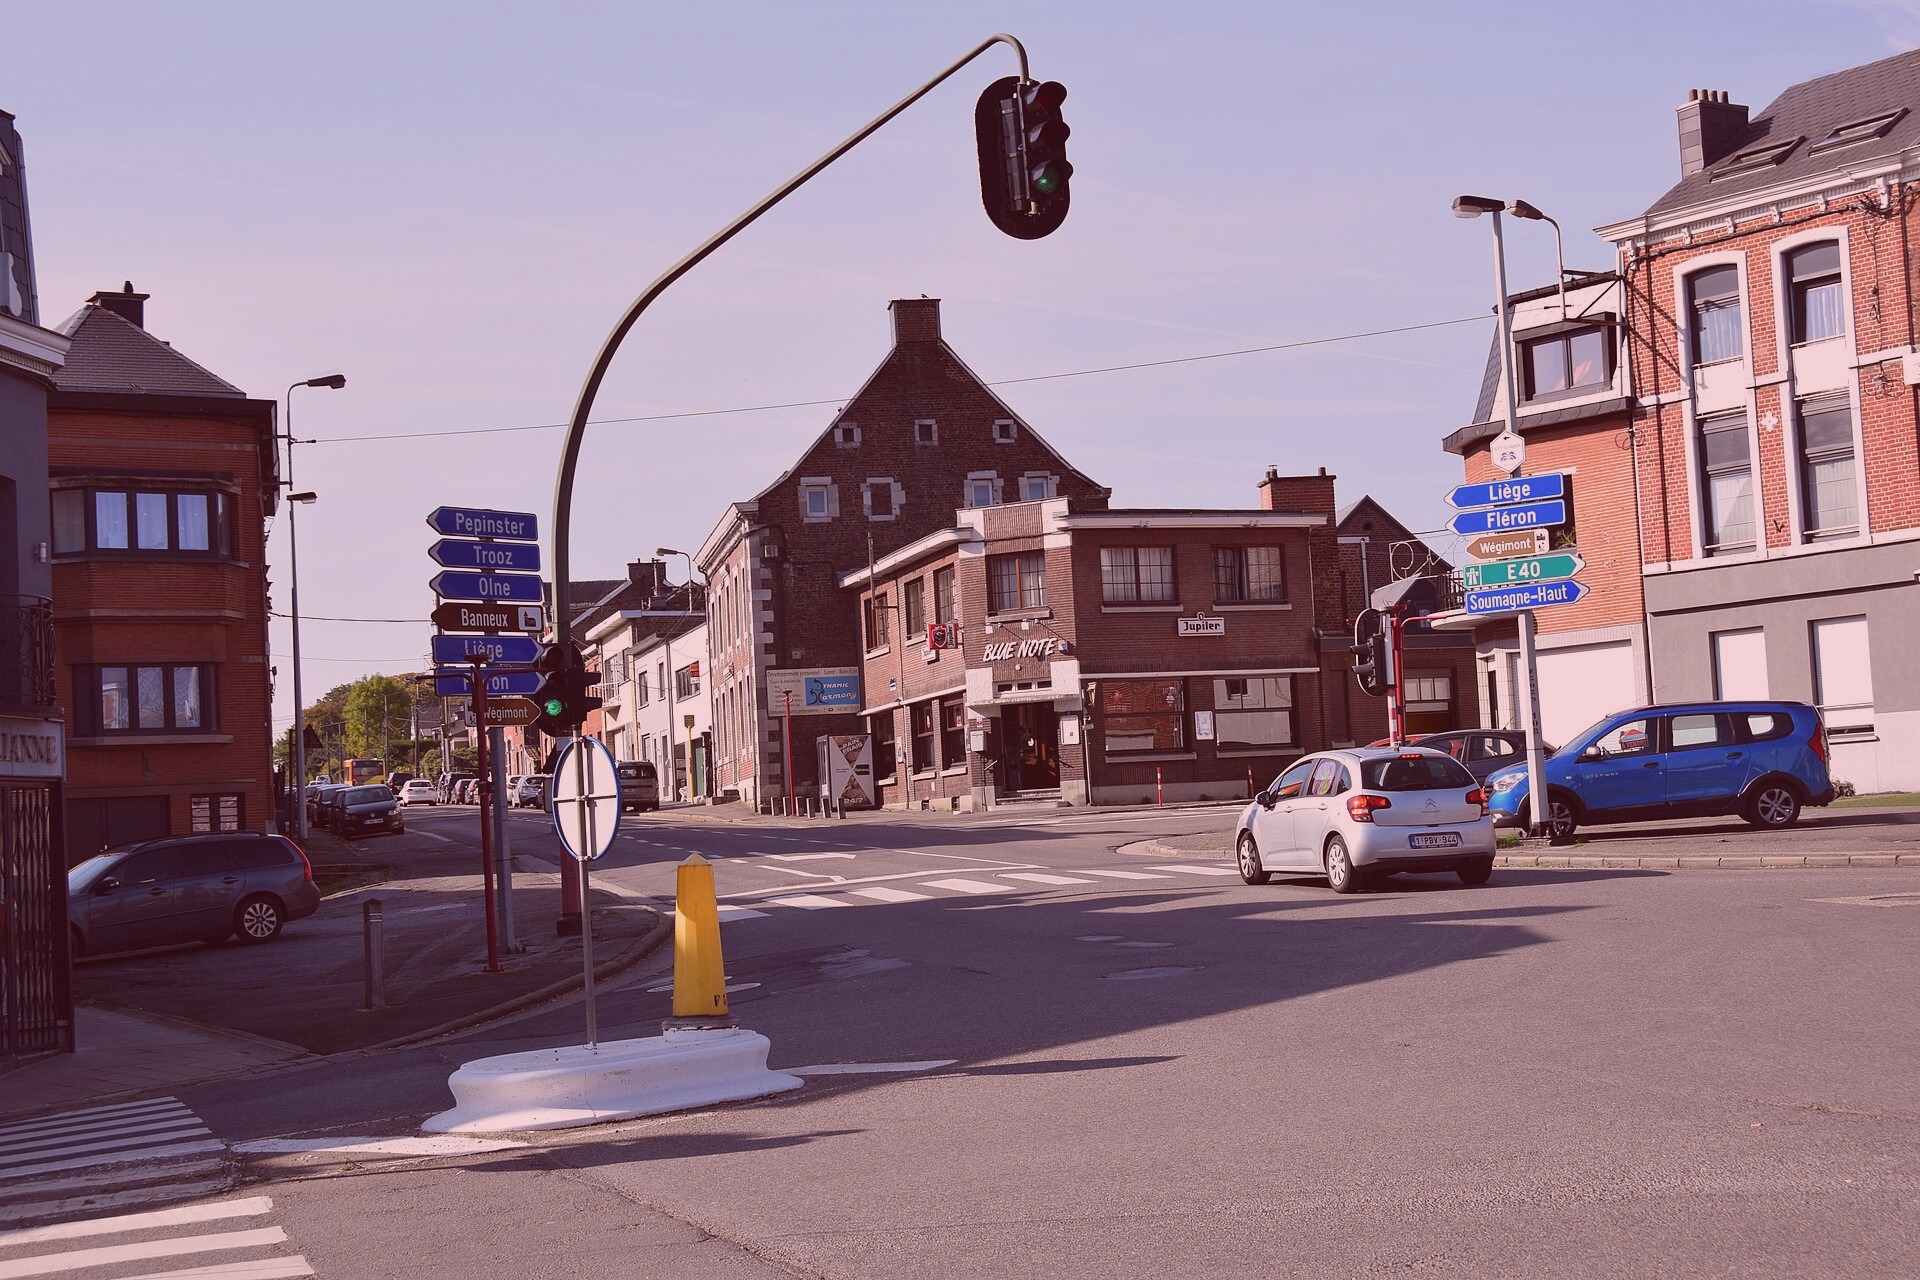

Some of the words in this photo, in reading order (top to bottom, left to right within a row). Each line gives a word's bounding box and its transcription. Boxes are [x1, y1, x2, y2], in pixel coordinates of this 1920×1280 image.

[1489, 484, 1531, 501] Liège
[455, 512, 525, 536] Pepinster
[1487, 510, 1537, 529] Fléron
[473, 546, 513, 566] Trooz
[1480, 538, 1531, 555] Wégimont
[479, 577, 511, 597] Olne
[1469, 584, 1568, 611] Soumagne-Haut
[461, 608, 509, 627] Banneux
[1183, 621, 1221, 632] Jupiler
[464, 640, 503, 662] Liège
[982, 641, 1017, 662] BLUE
[1017, 637, 1058, 658] NOTE
[0, 733, 57, 764] IANNE
